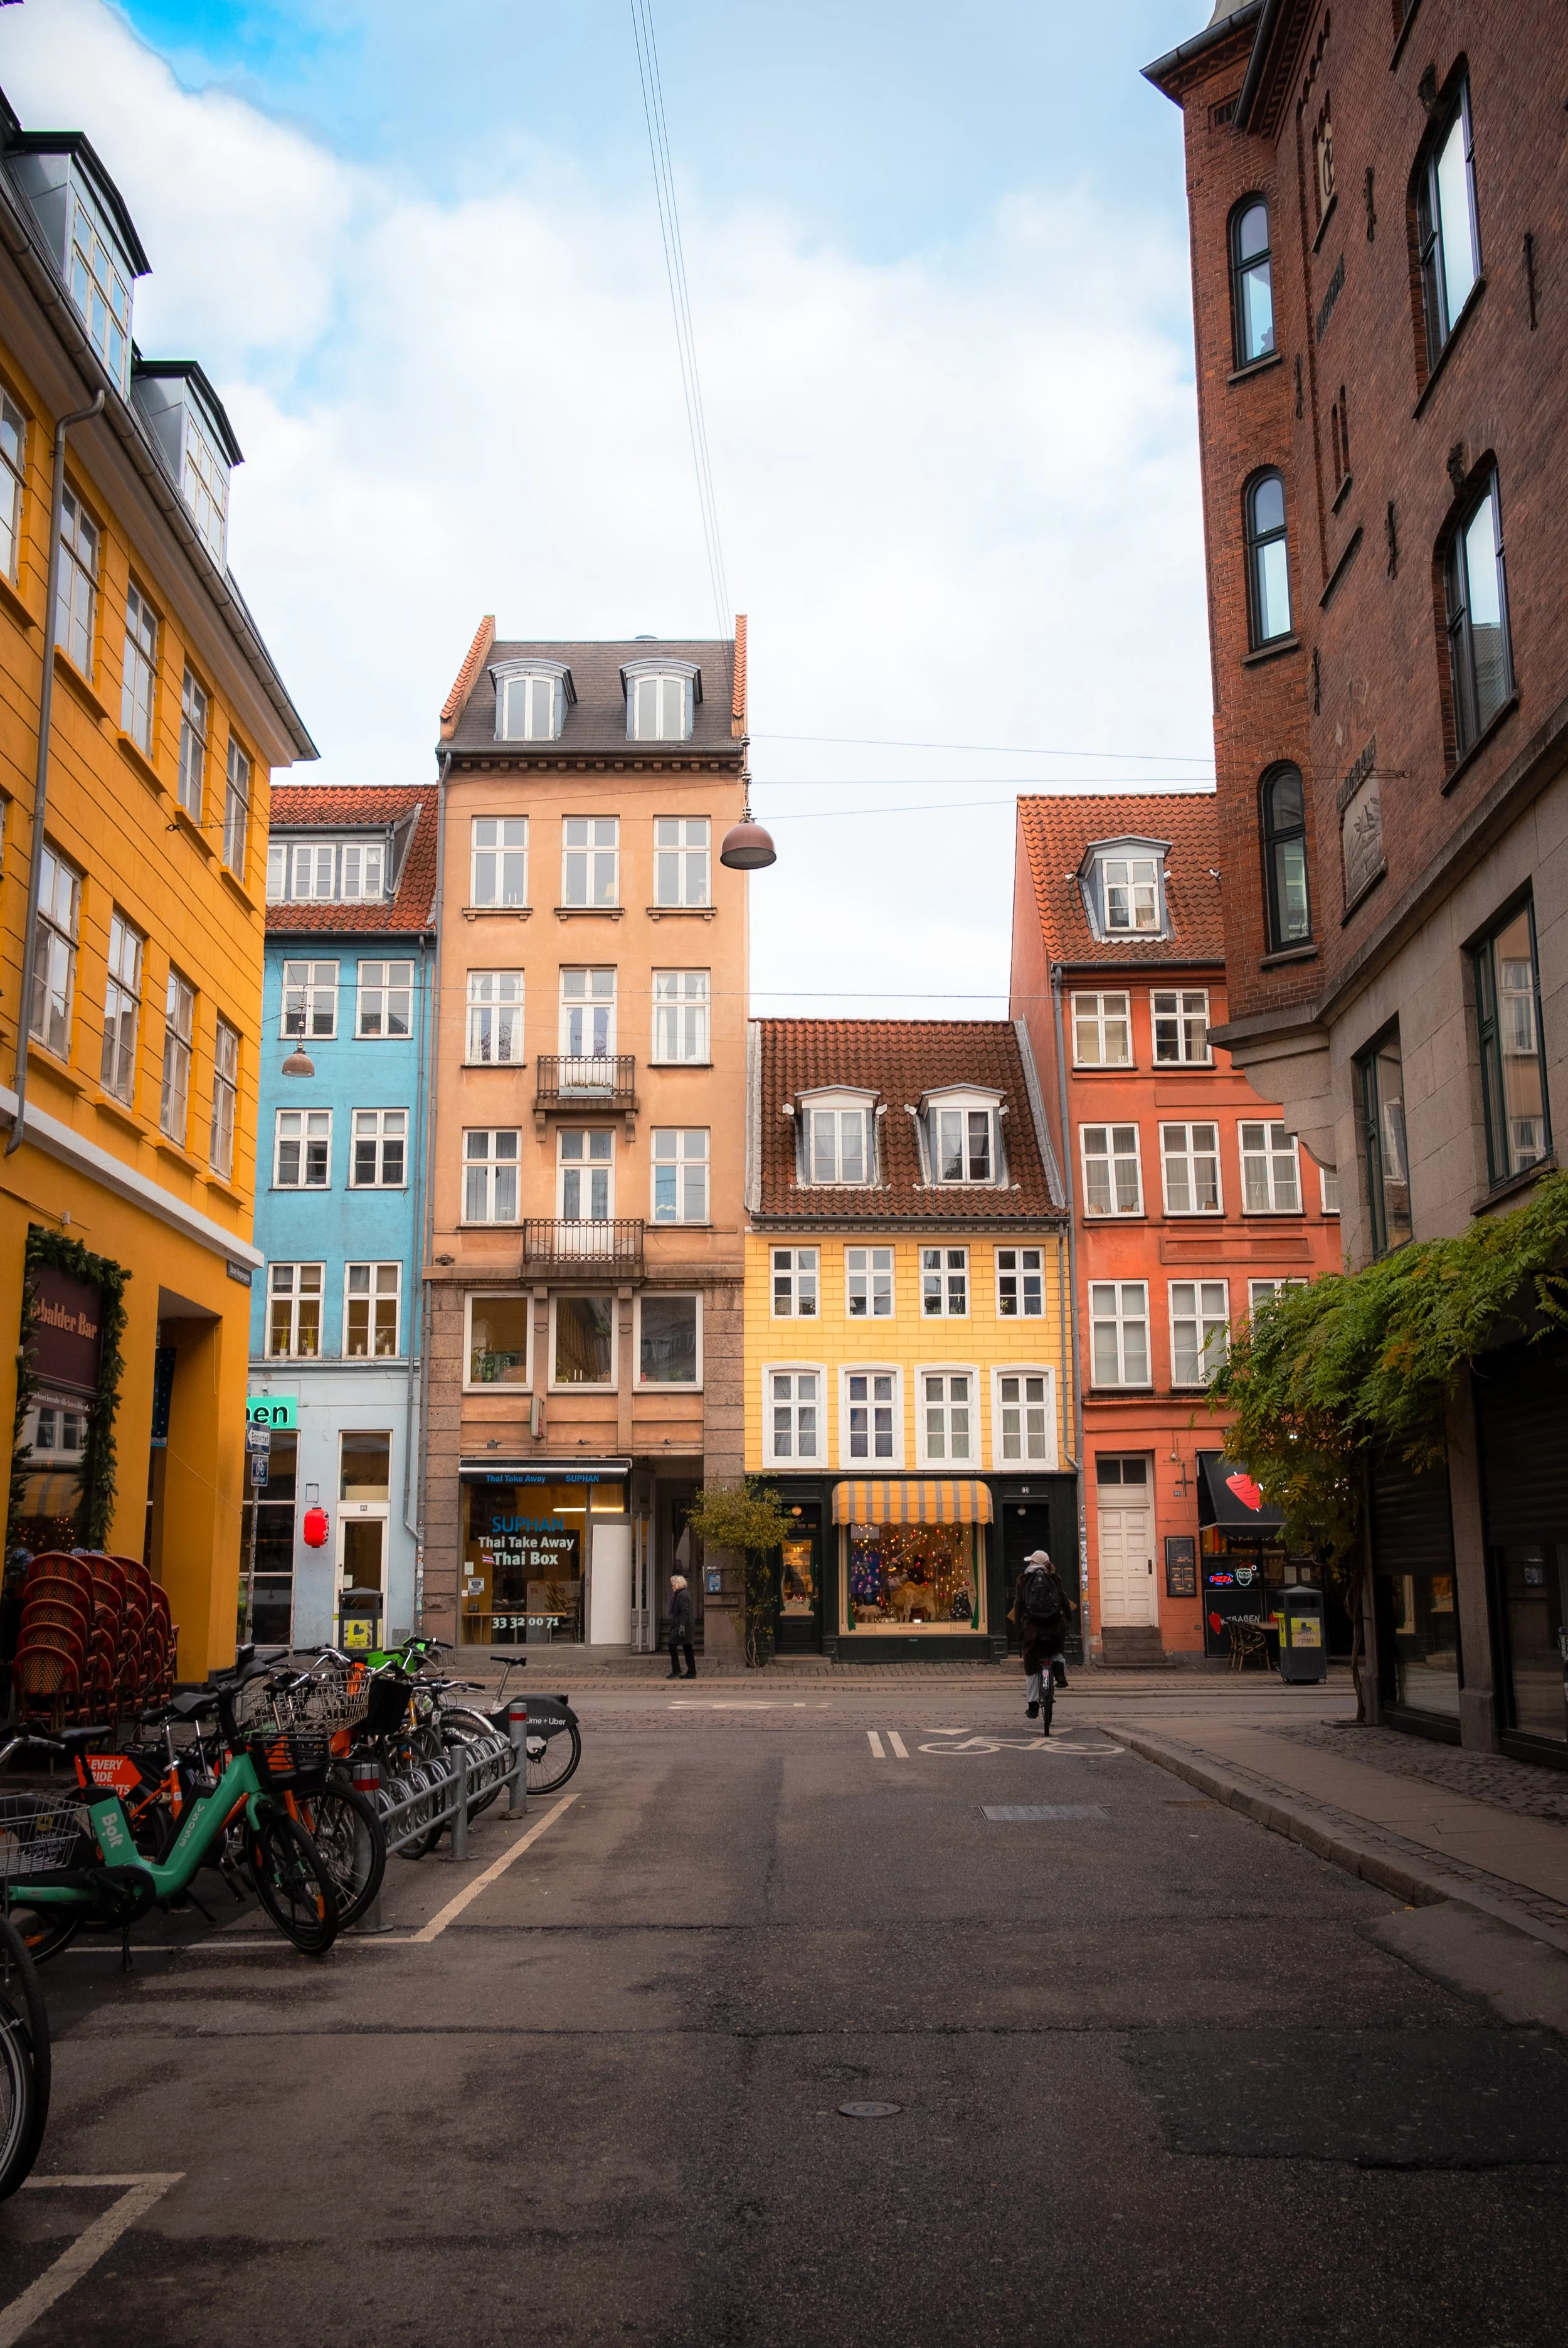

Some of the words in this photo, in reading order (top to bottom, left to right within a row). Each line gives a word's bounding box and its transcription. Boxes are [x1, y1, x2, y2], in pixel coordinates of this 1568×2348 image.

[77, 1312, 98, 1340] Bar
[252, 1431, 268, 1445] Ensrettet
[525, 1475, 546, 1484] Away
[492, 1516, 564, 1533] SUPHAN
[478, 1536, 505, 1548] Thai
[508, 1536, 538, 1548] Take
[540, 1536, 575, 1551] Away
[493, 1551, 526, 1566] Thai
[530, 1551, 559, 1565] Box
[492, 1617, 507, 1629] 33
[509, 1617, 525, 1629] 32
[528, 1617, 544, 1626] 00
[546, 1617, 559, 1629] 71
[91, 1759, 124, 1770] EVERY
[92, 1772, 113, 1782] RIDE
[102, 1812, 124, 1848] Bolt
